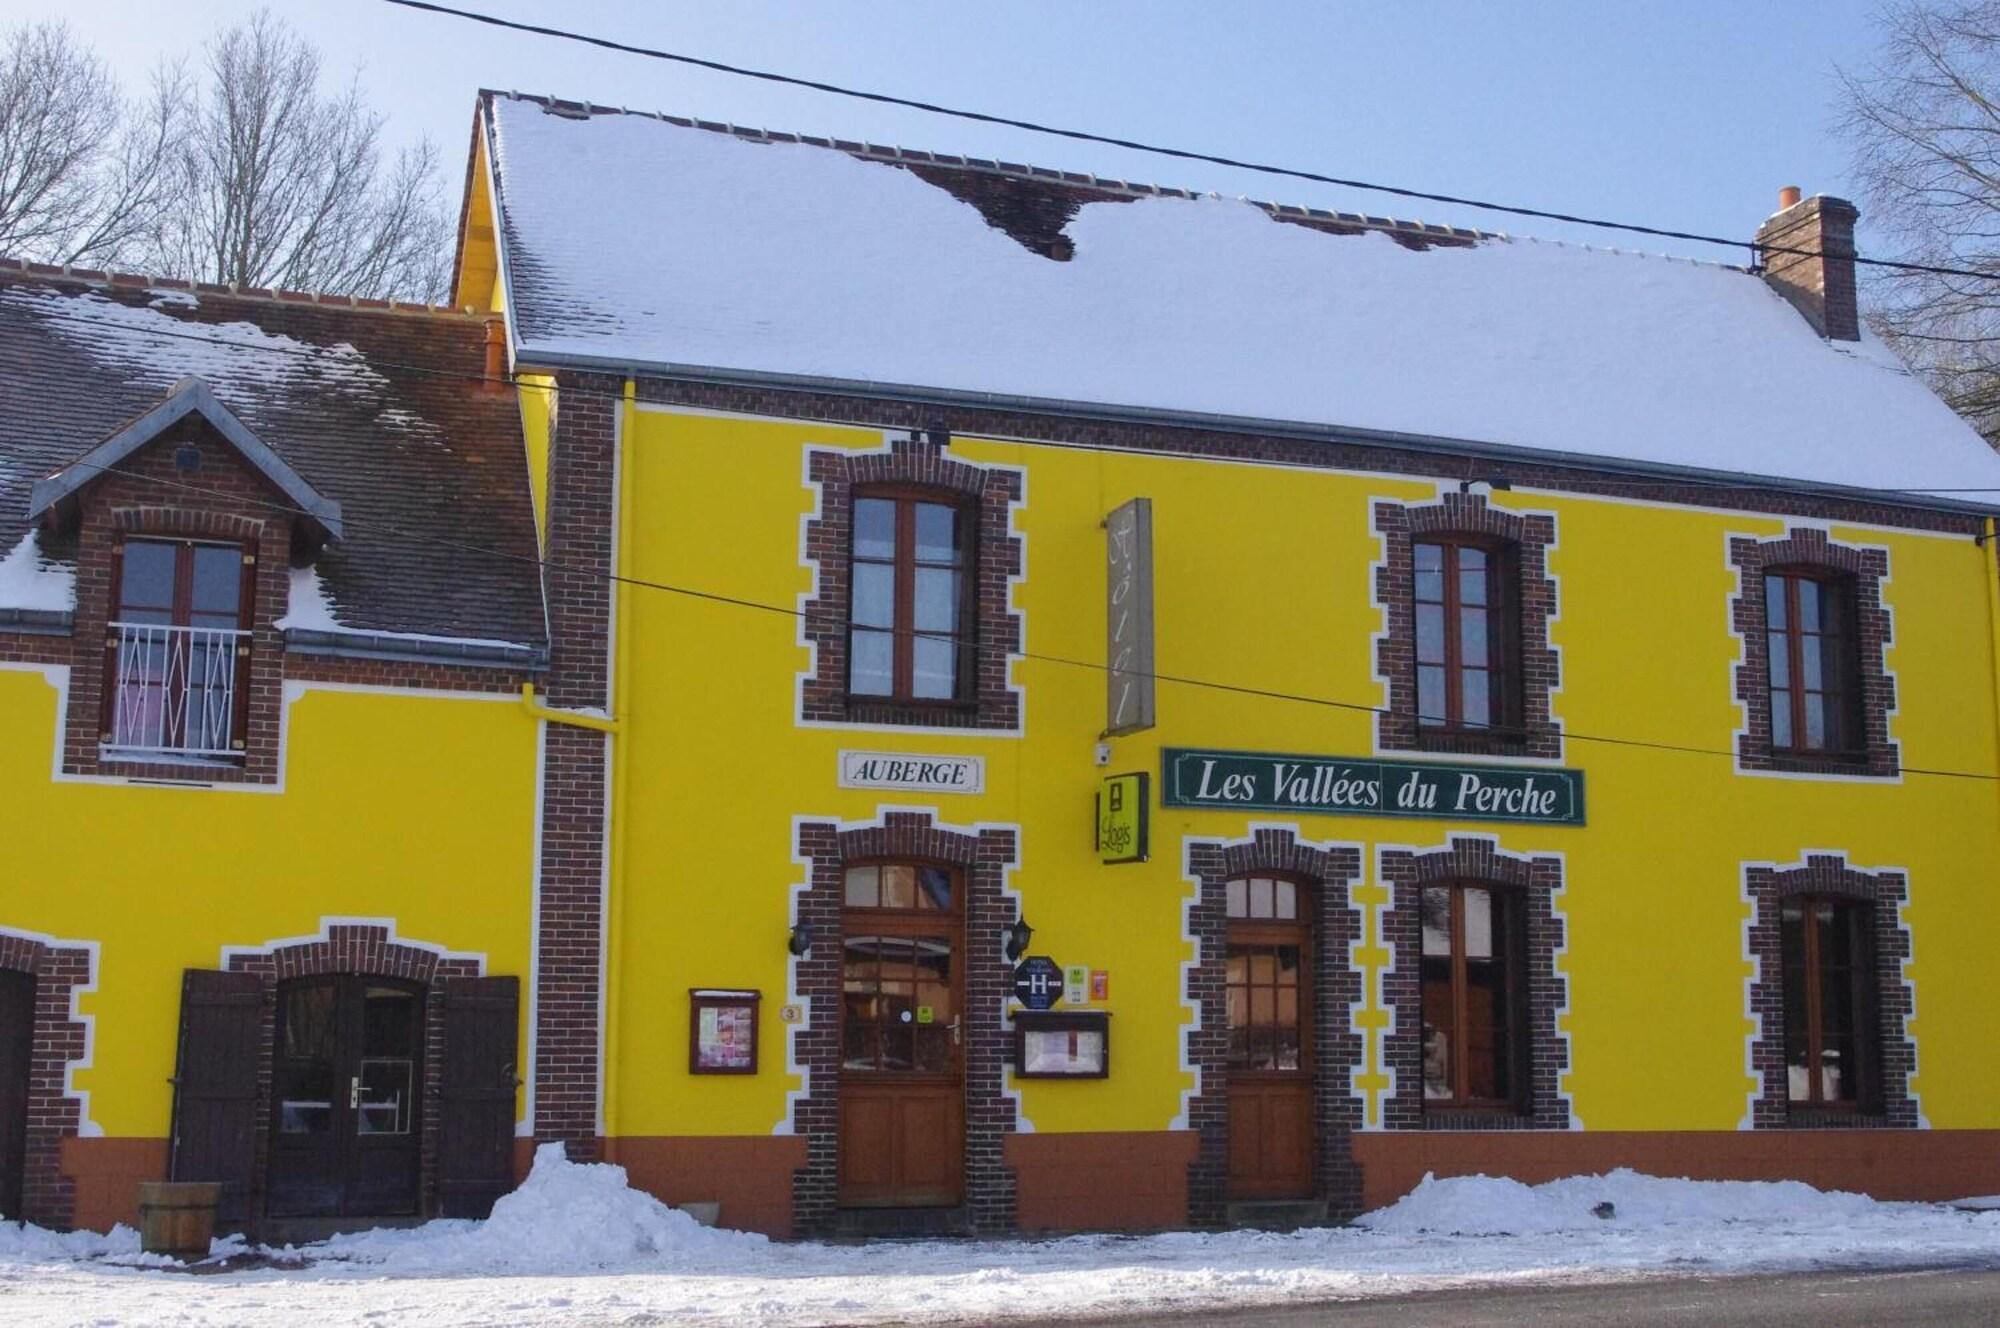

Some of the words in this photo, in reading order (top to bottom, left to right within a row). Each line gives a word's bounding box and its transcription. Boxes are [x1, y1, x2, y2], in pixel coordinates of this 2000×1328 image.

[853, 759, 968, 785] AUBERGE
[1195, 759, 1256, 801] Les
[1272, 763, 1381, 807] Vallées
[1397, 771, 1436, 810] du
[1454, 773, 1557, 815] Perche
[1101, 814, 1131, 854] Logis
[1030, 974, 1047, 994] H
[785, 1008, 795, 1019] 3
